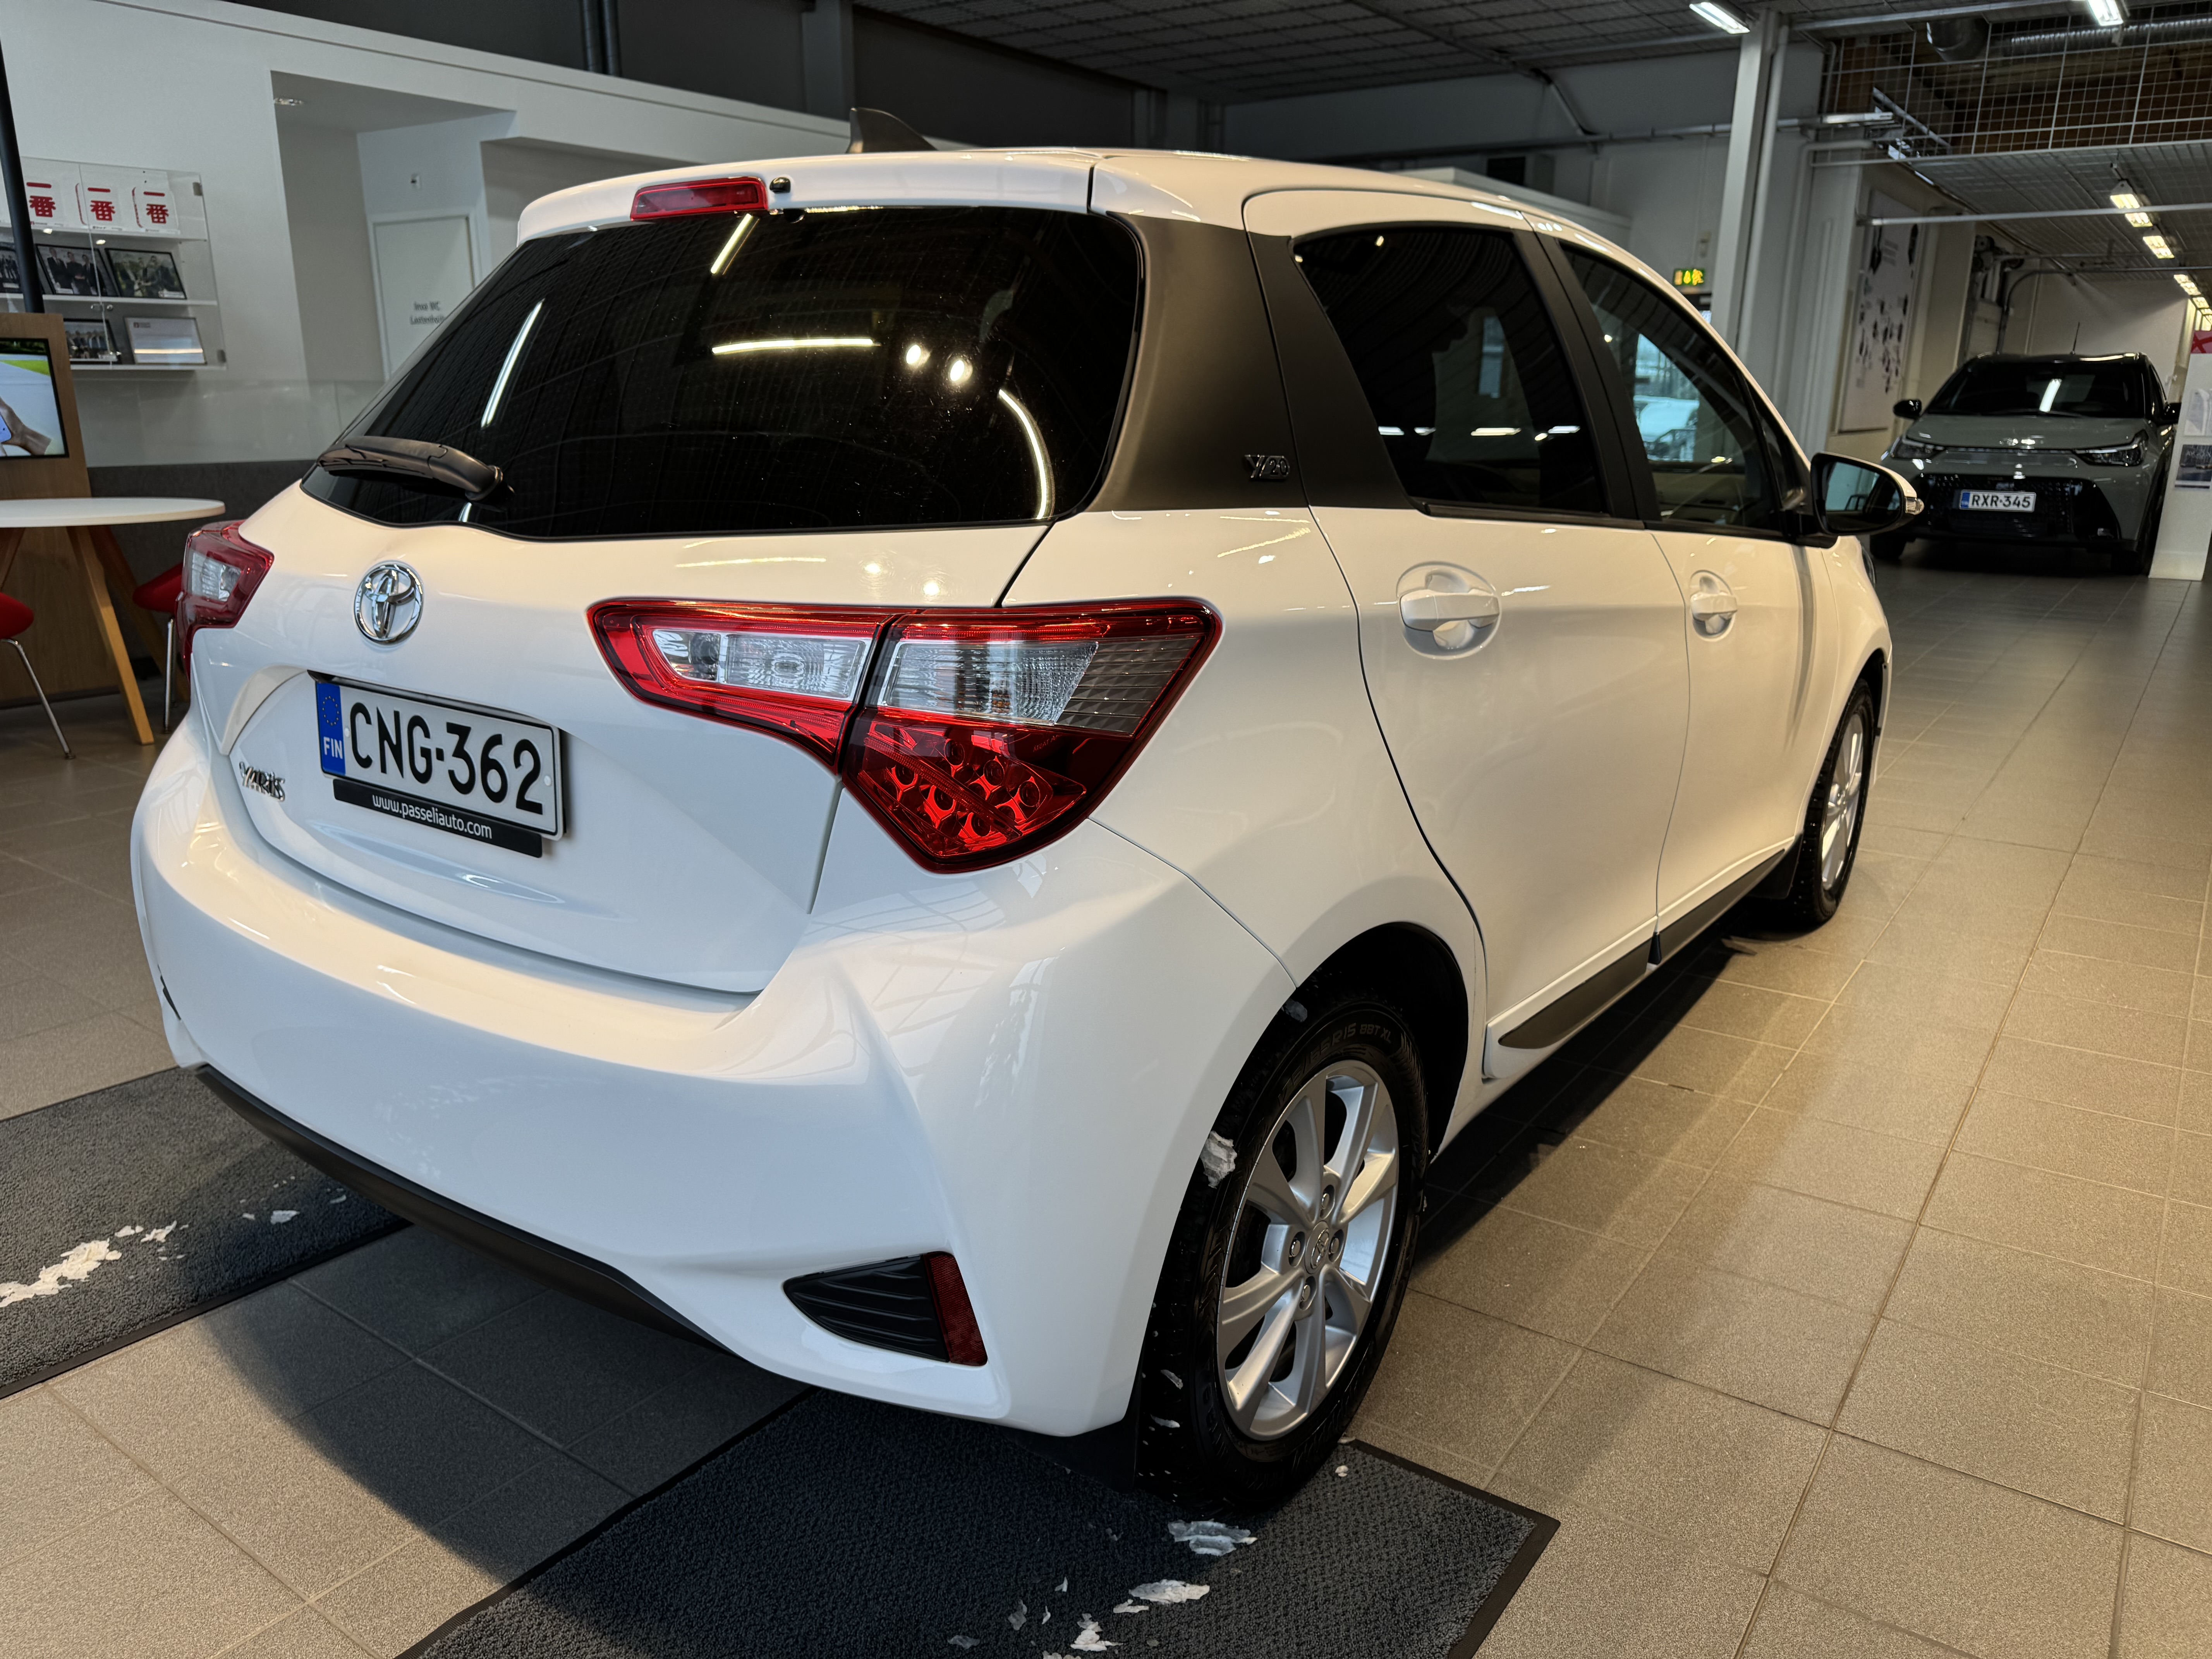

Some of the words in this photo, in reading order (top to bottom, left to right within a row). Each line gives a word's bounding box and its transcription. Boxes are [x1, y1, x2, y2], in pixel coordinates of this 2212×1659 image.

[88, 187, 115, 222] 一番
[143, 191, 169, 224] 一番
[1972, 495, 2031, 508] RXR-345
[323, 736, 343, 760] FIN
[350, 701, 543, 815] CNG-362
[372, 794, 493, 840] www.passeliauto.com
